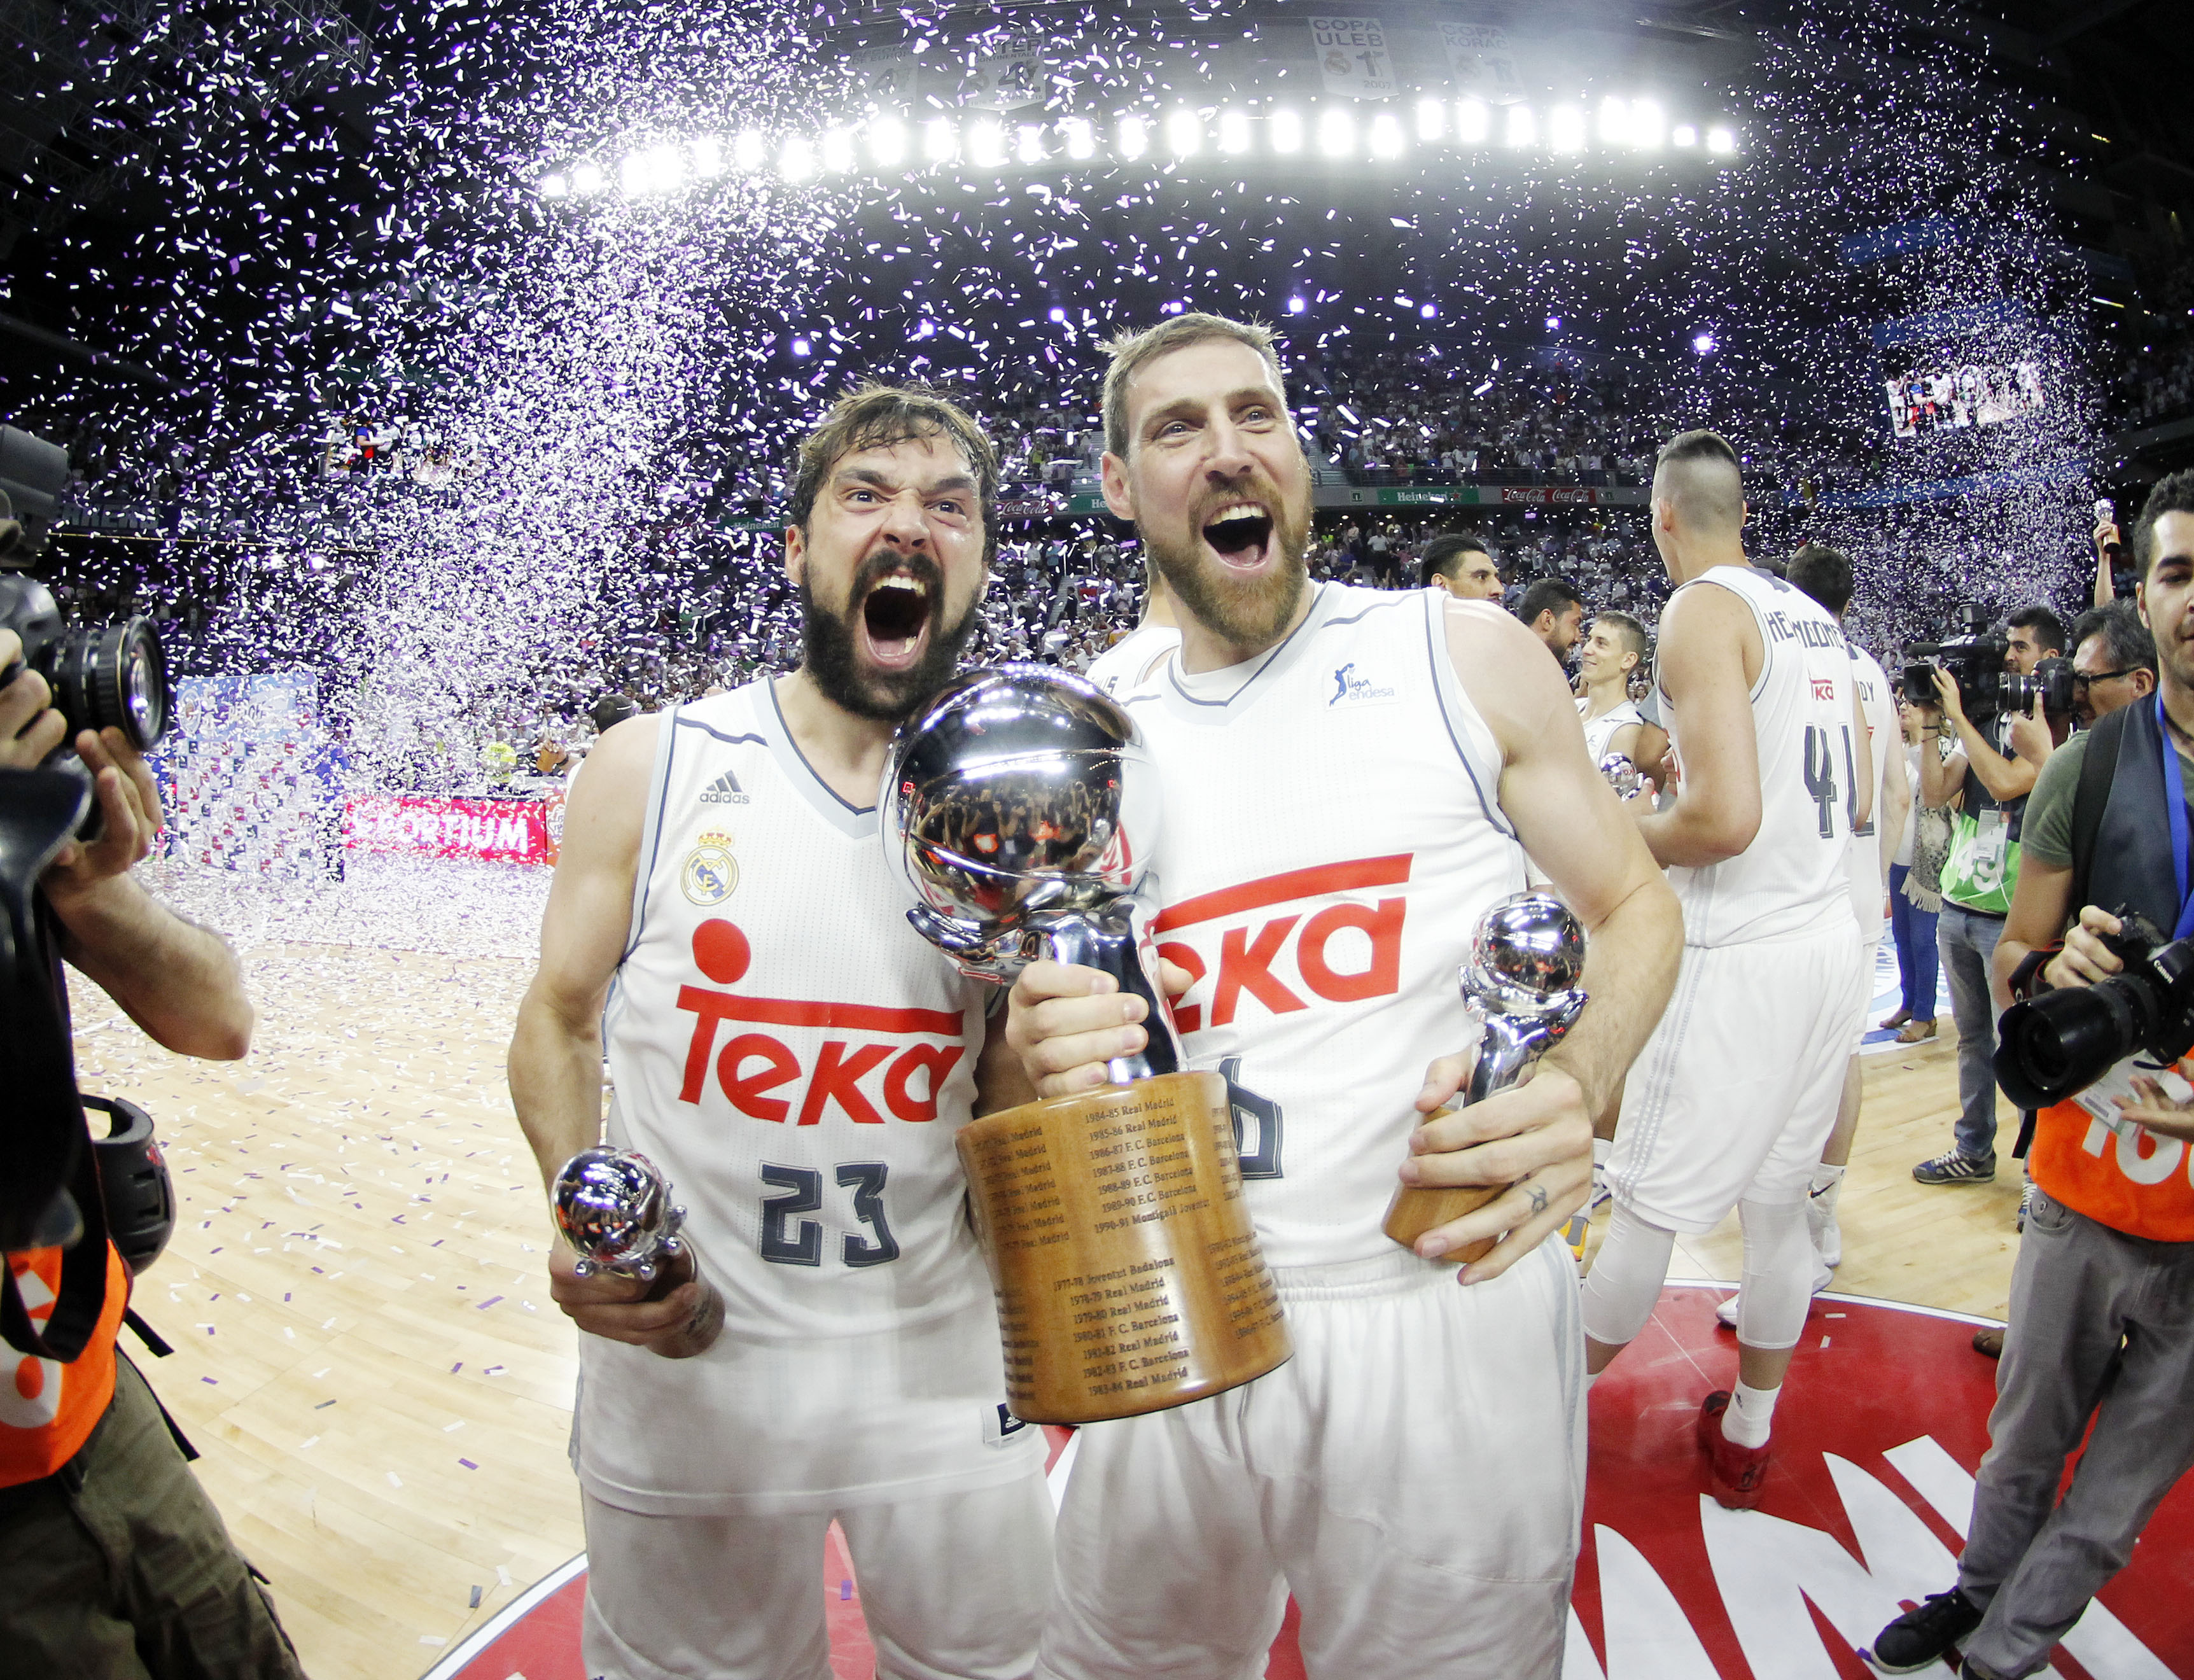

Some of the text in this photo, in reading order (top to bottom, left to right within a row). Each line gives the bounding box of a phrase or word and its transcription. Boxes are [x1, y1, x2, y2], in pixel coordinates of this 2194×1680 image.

[1313, 20, 1382, 31] COPA
[1317, 32, 1383, 46] ULEB
[1397, 491, 1448, 503] Heineken
[1347, 675, 1371, 691] liga
[1348, 686, 1395, 701] endesa
[700, 788, 750, 804] adidas
[1151, 852, 1415, 1035] eka
[2153, 959, 2174, 984] Canon
[1122, 1103, 1142, 1116] Real
[1145, 1097, 1175, 1112] Madrid
[1126, 1121, 1145, 1133] Real
[1149, 1115, 1177, 1129] Madrid
[1147, 1133, 1185, 1147] Barcelona
[1149, 1150, 1189, 1165] Barcelona
[1154, 1166, 1193, 1182] Barcelona
[1158, 1184, 1197, 1200] Barcelona
[758, 1159, 900, 1267] 23
[1129, 1257, 1176, 1275] Badalona
[1105, 1287, 1127, 1299] Real
[1129, 1277, 1166, 1293] Madrid
[1110, 1305, 1132, 1318] Real
[1134, 1294, 1170, 1311] Madrid
[1131, 1313, 1180, 1331] Barcelona
[1119, 1340, 1141, 1353] Real
[1144, 1330, 1179, 1347] Madrid
[1142, 1349, 1190, 1368] Barcelona
[1126, 1376, 1149, 1390] Real
[1151, 1366, 1188, 1385] Madrid
